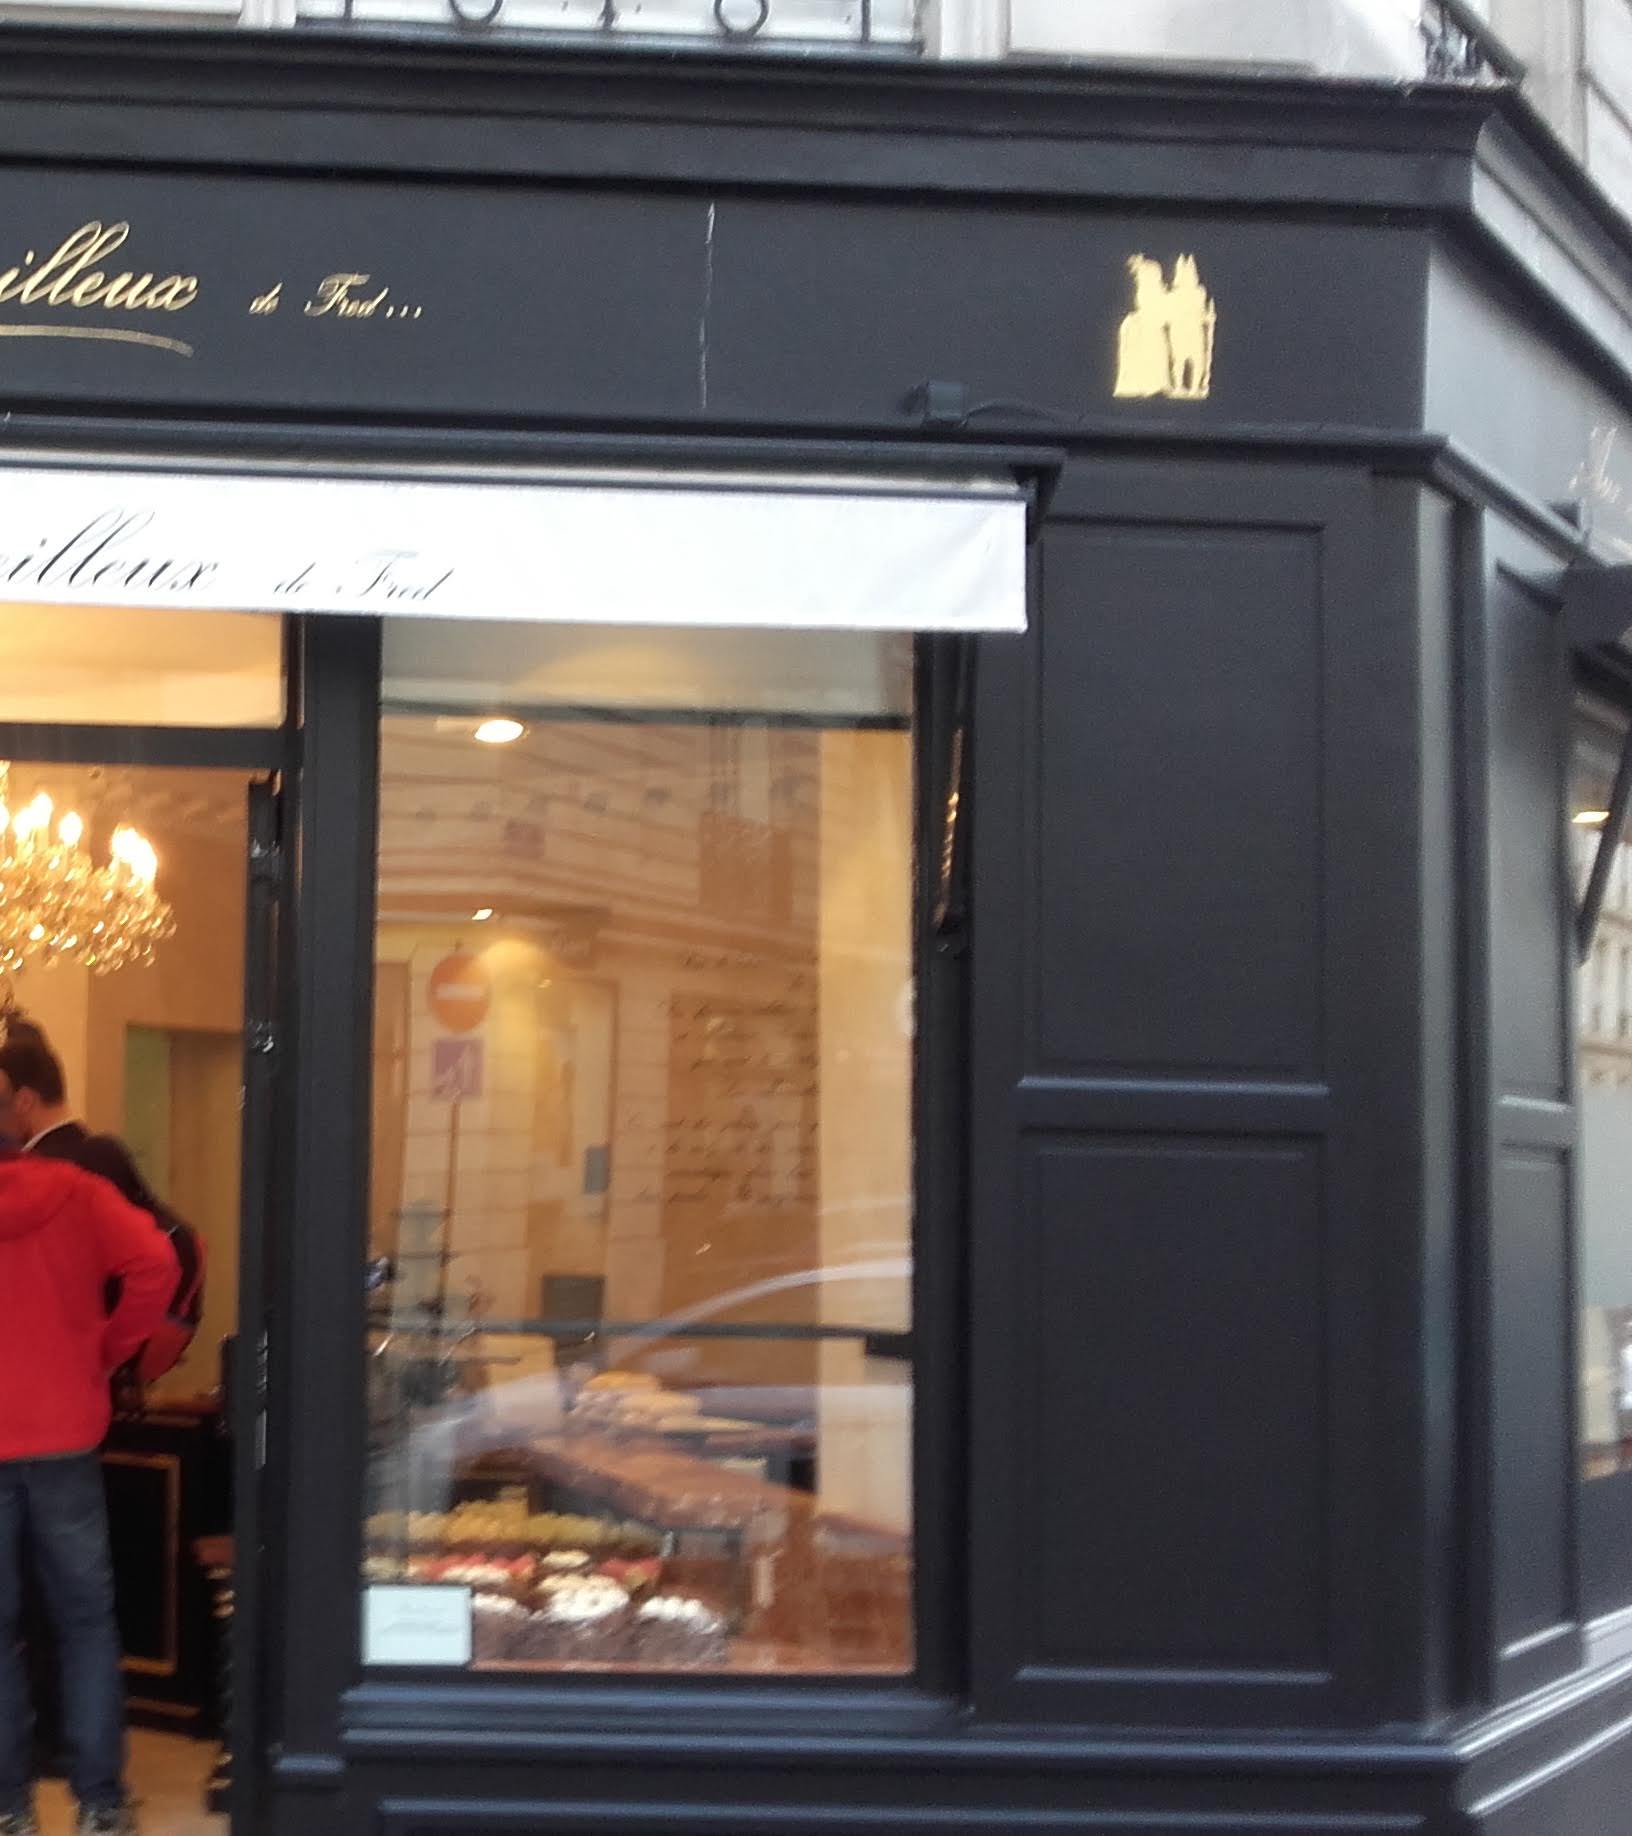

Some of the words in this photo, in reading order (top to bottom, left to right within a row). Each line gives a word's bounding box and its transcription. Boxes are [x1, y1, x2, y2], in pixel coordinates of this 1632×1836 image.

[248, 281, 283, 316] de
[273, 560, 316, 595] de
[335, 549, 454, 600] Fred
